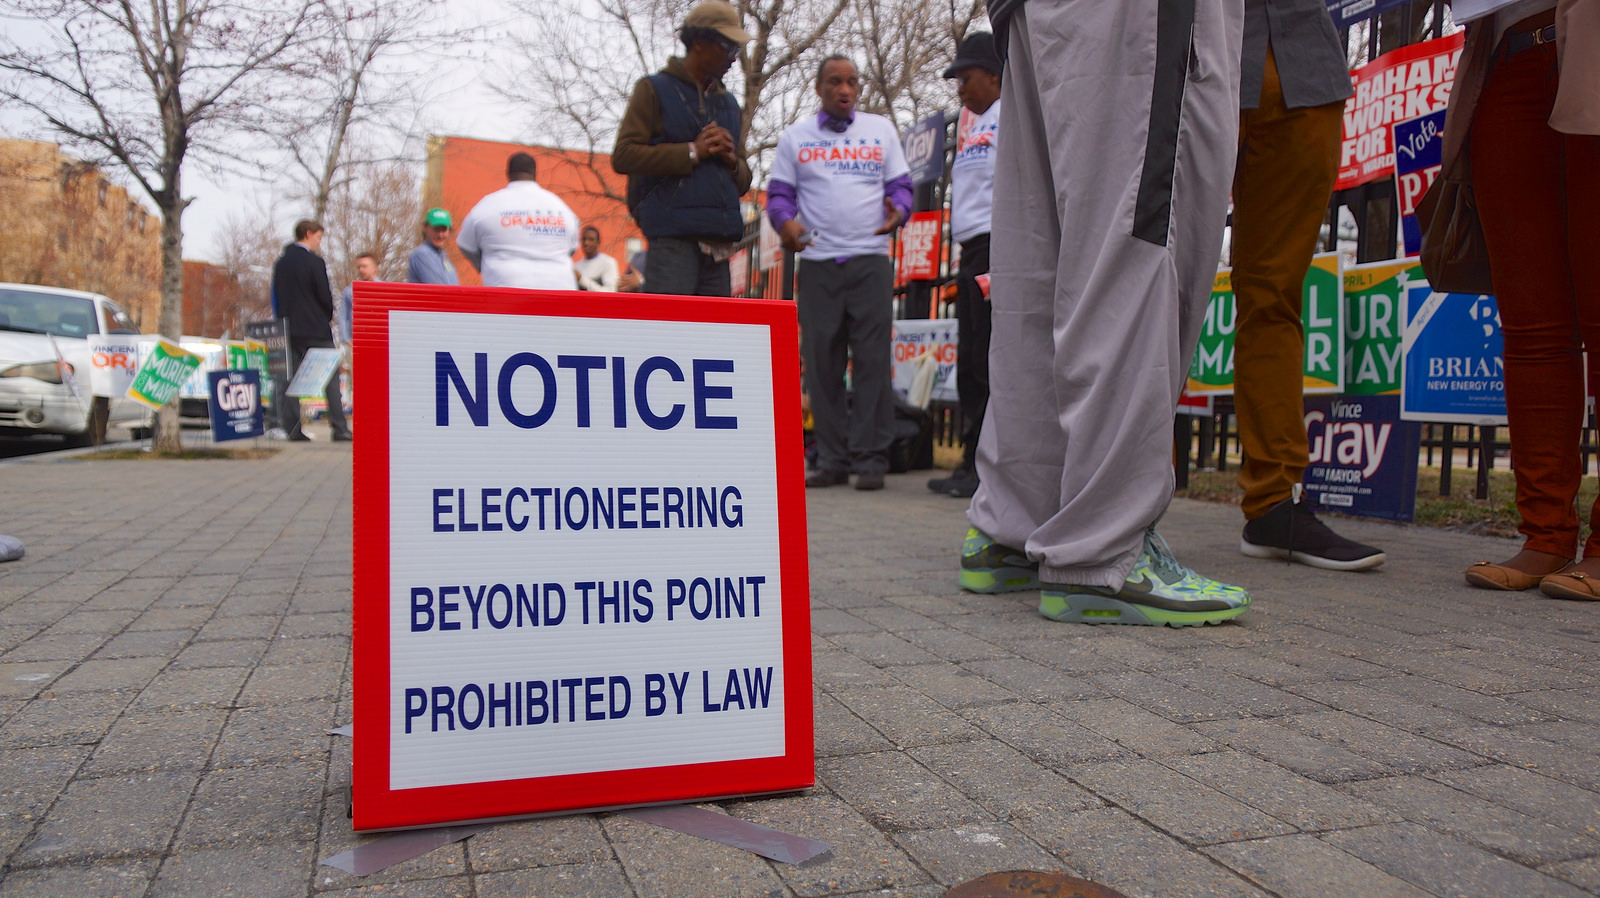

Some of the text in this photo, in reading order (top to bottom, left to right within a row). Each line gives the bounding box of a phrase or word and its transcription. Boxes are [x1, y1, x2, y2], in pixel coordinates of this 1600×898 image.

[1343, 81, 1454, 139] WORKS
[797, 146, 884, 164] ORANGE
[1341, 127, 1386, 167] FOR
[1398, 120, 1437, 160] Vote
[838, 161, 882, 172] MAYOR
[501, 215, 566, 228] ORANGE
[91, 345, 135, 353] VINCEN
[895, 343, 957, 363] ORANG
[217, 377, 257, 416] Gray
[435, 351, 738, 430] NOTICE
[1427, 381, 1504, 391] NEW ENERGY FO
[1331, 400, 1362, 419] Vince
[1304, 410, 1392, 479] Gray
[1325, 468, 1362, 483] MAYOR
[432, 485, 744, 533] ELECTIONEERING
[410, 575, 766, 632] BEYOND THIS POINT
[404, 666, 774, 735] PROHIBITED BY LAW
